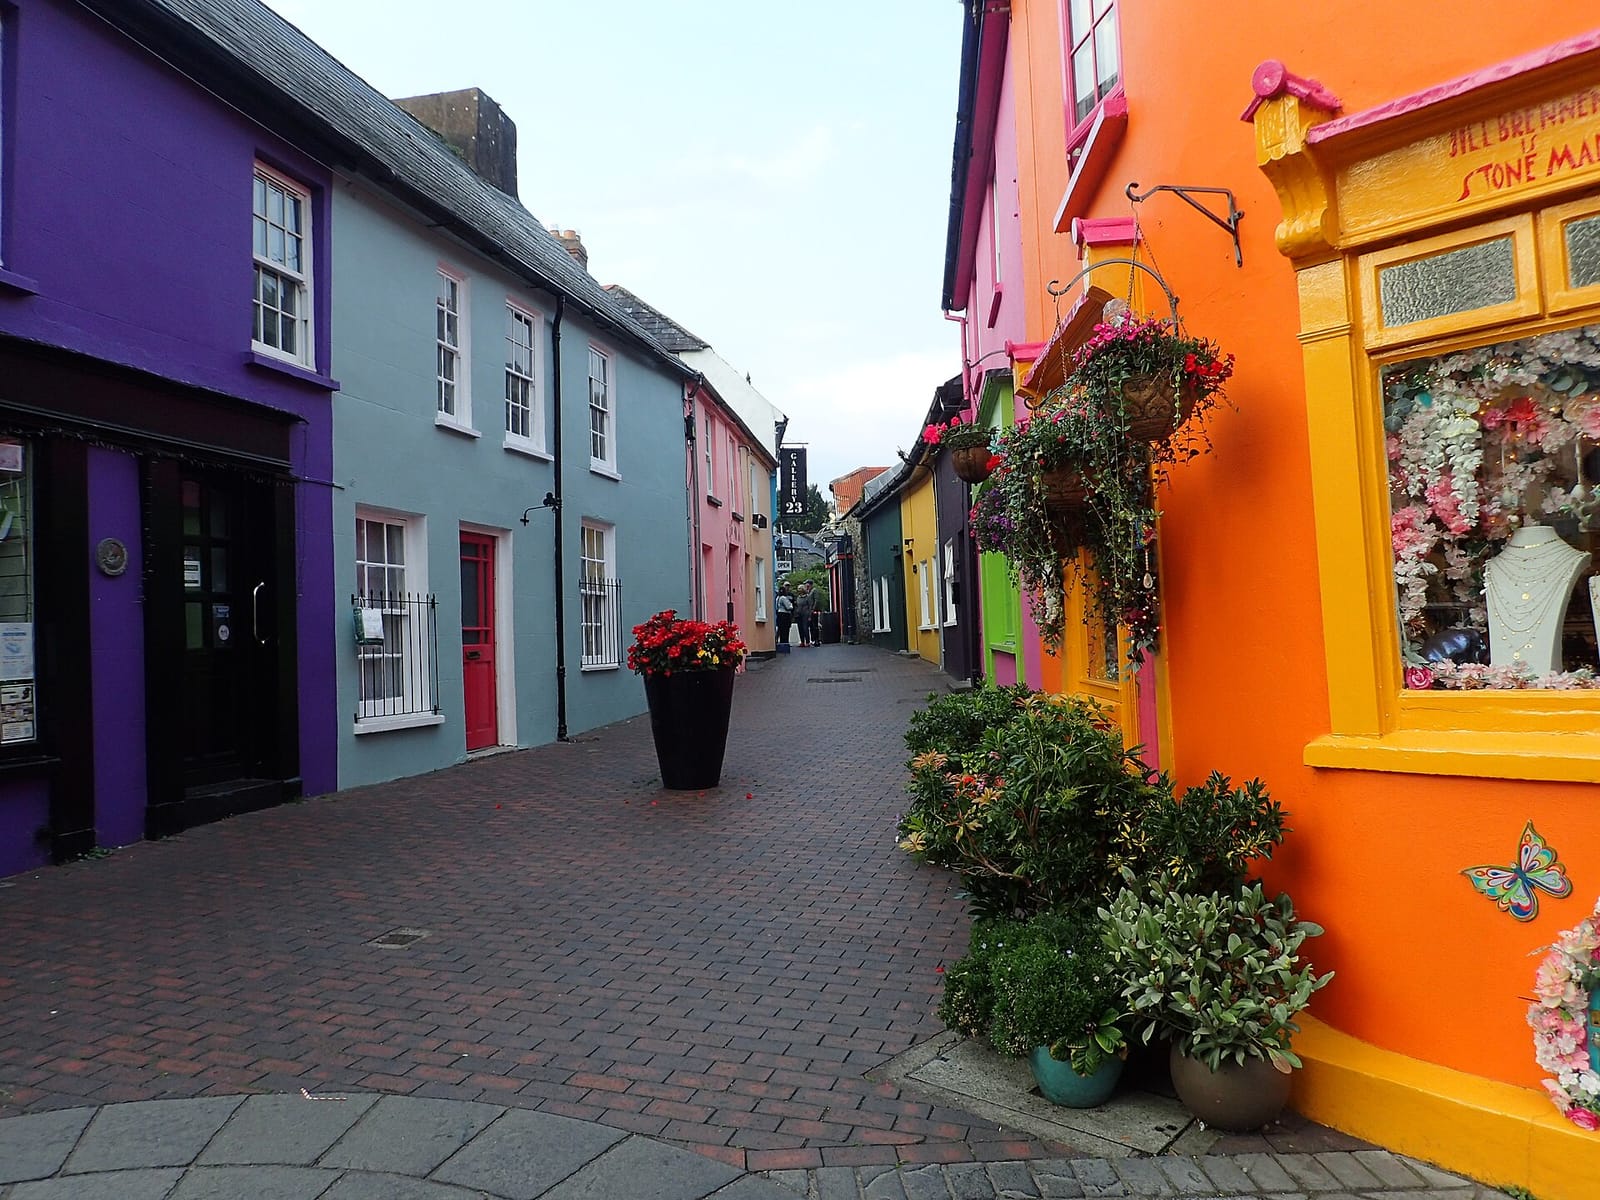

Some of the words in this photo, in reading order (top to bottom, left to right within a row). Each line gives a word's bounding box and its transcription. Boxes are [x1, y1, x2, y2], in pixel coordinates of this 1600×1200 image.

[1449, 120, 1491, 157] JILL
[1521, 134, 1538, 153] IS
[1457, 153, 1537, 202] STONE
[790, 453, 798, 502] GALLERY
[786, 502, 803, 514] 23
